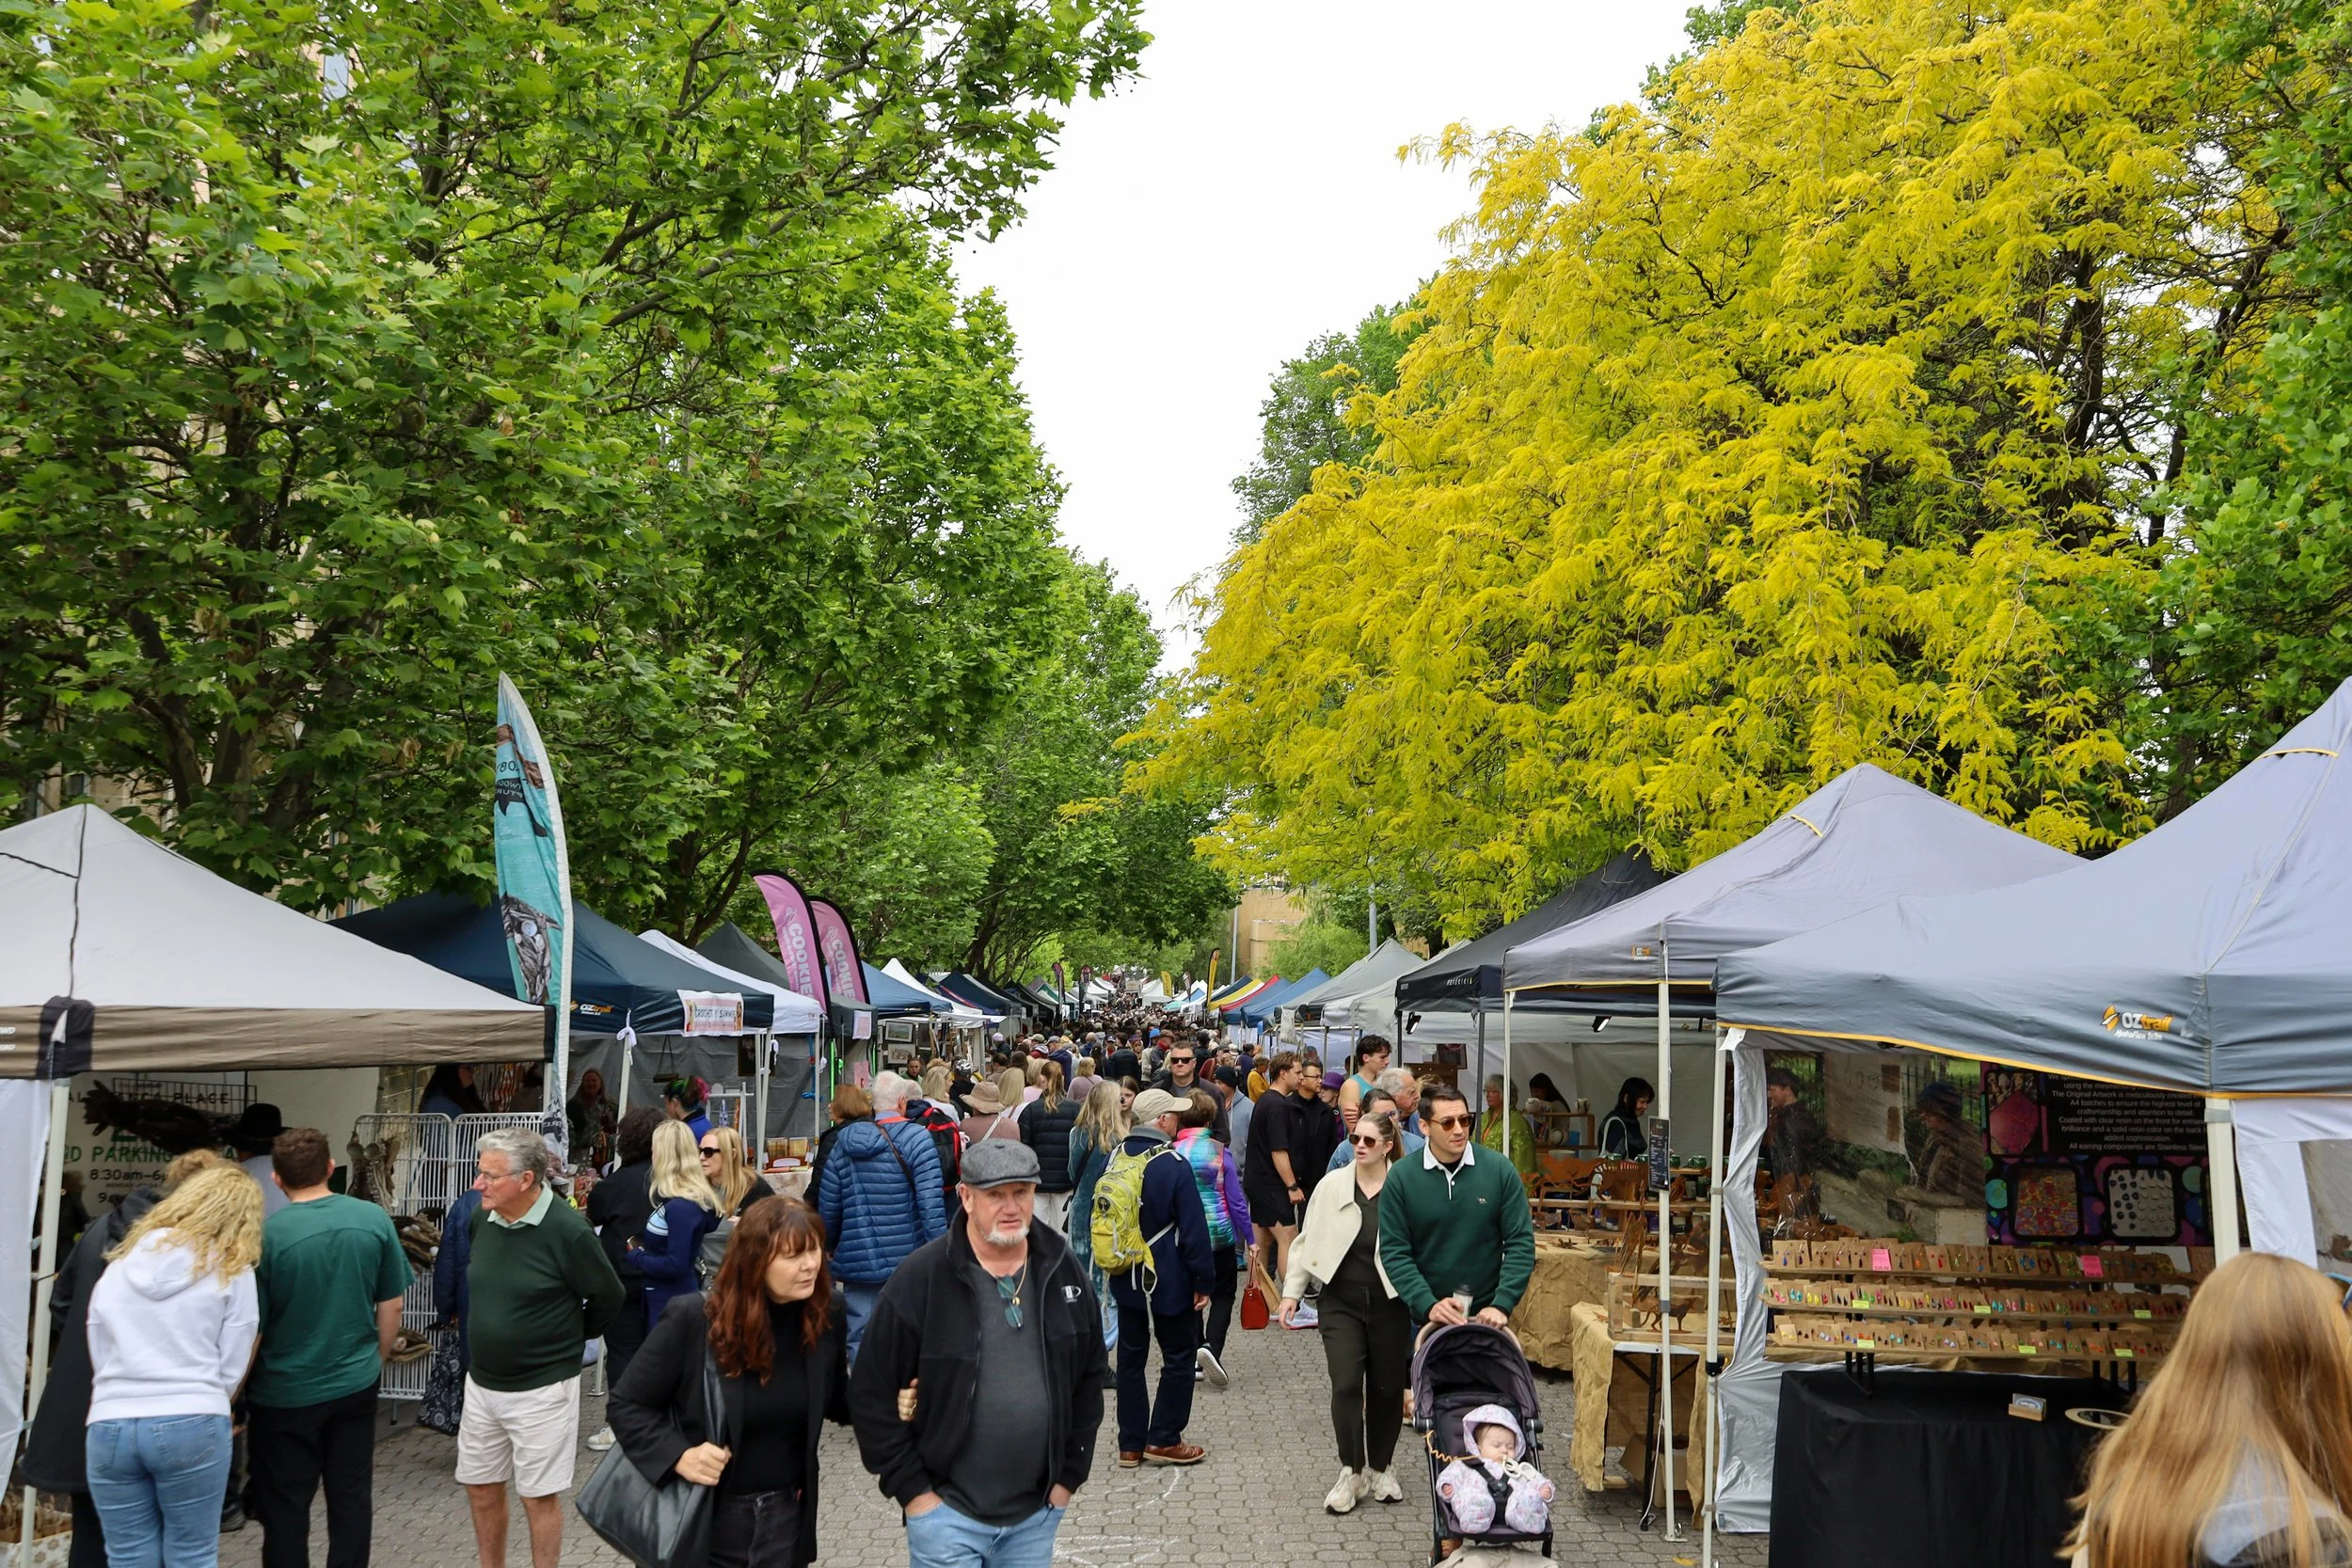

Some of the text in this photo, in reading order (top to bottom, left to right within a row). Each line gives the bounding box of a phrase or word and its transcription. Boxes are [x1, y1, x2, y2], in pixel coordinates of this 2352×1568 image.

[788, 923, 814, 999] COOKIE
[831, 939, 856, 1000] COOKIE
[2122, 1012, 2173, 1032] OZtrail
[173, 1092, 229, 1104] PLACE
[91, 1146, 173, 1163] PARKING
